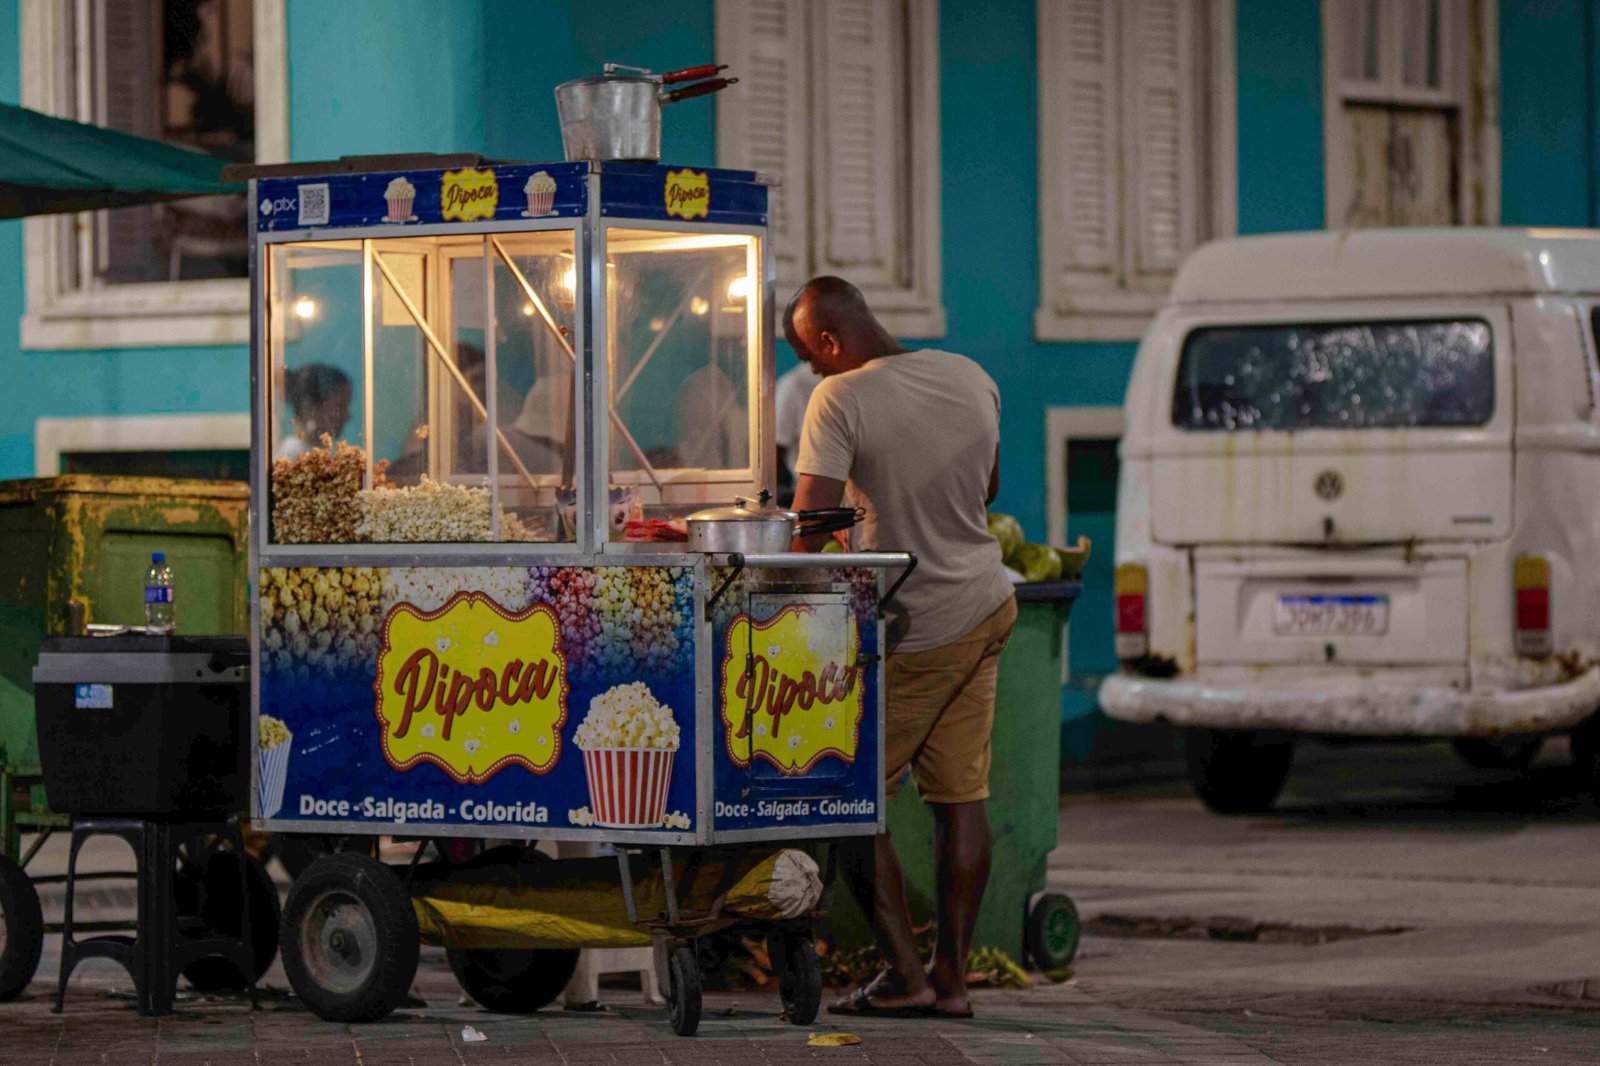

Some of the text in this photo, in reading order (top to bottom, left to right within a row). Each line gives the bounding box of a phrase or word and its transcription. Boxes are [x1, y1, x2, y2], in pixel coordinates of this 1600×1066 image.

[446, 183, 495, 211] Pipoca
[669, 183, 707, 208] Pipoca
[393, 648, 558, 741] Pipoca
[735, 654, 859, 739] Pipoca
[299, 795, 349, 816] Doce
[362, 796, 445, 824] Salgada
[459, 800, 548, 823] Colorida
[715, 801, 748, 817] Doce
[757, 801, 809, 821] Salgada
[819, 799, 875, 815] Colorida
